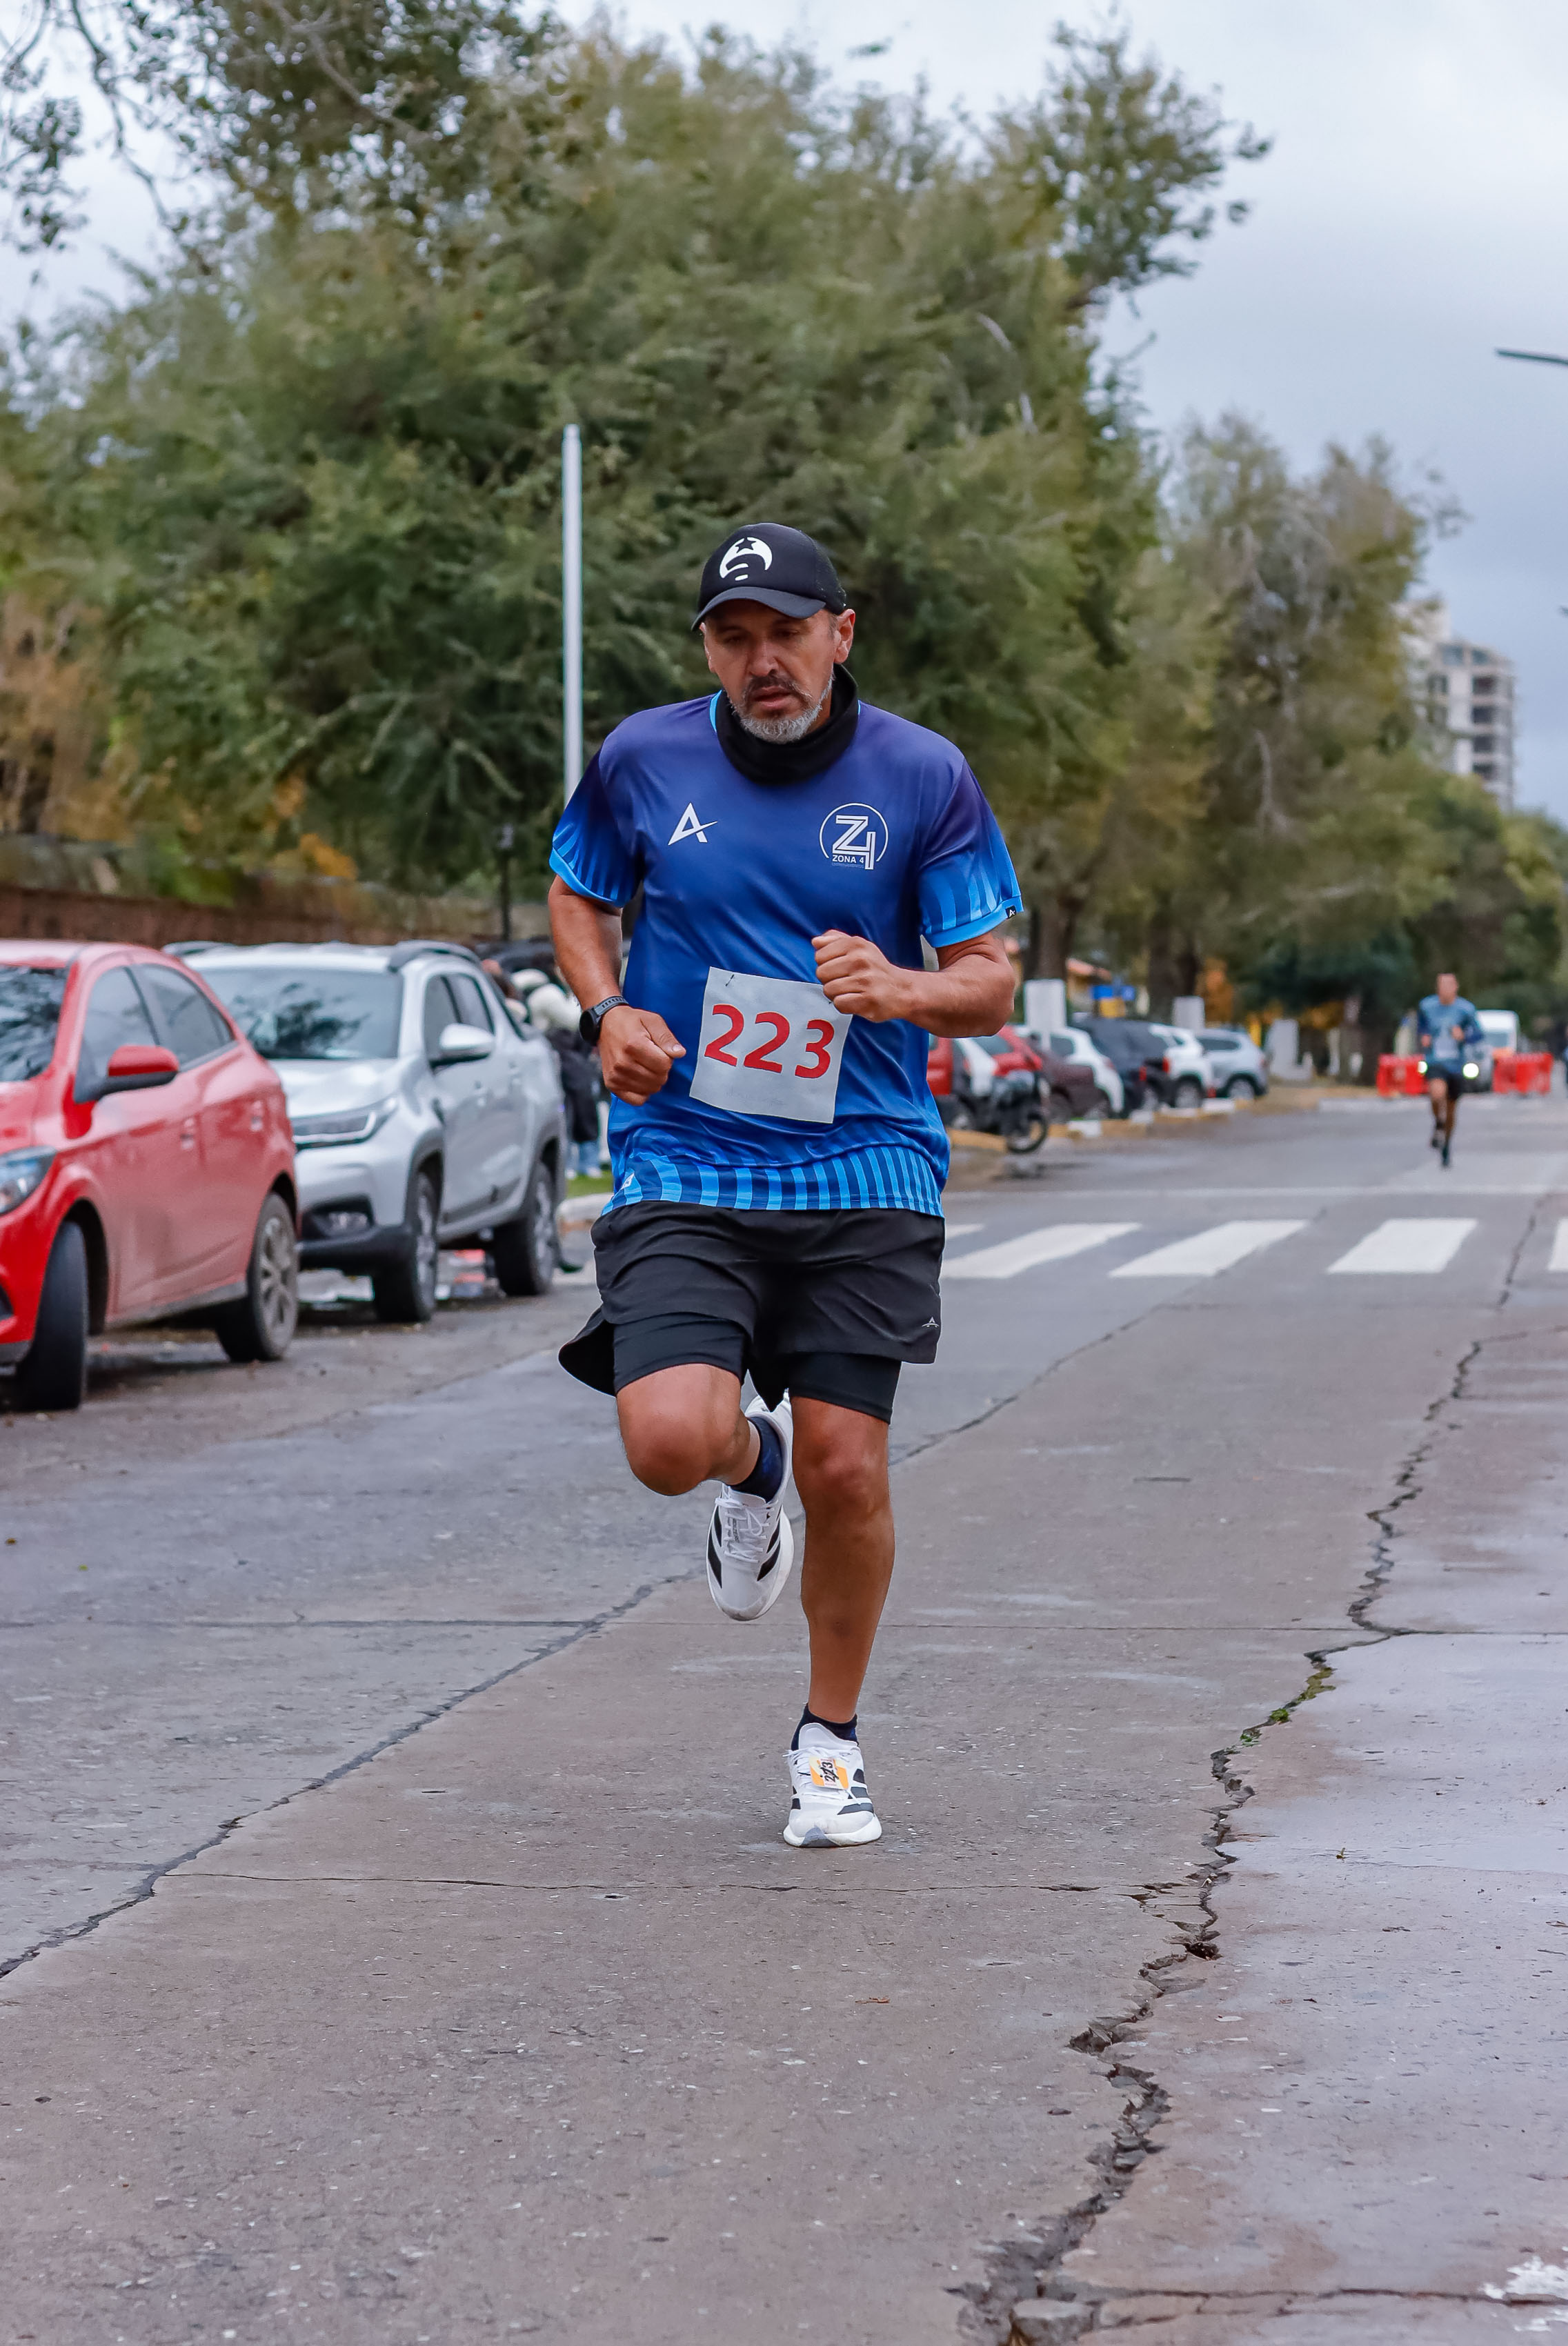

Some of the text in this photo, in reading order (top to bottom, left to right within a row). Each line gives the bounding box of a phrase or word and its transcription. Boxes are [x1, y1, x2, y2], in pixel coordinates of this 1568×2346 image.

[832, 854, 857, 863] ZONA
[704, 1004, 835, 1079] 223
[822, 1761, 837, 1783] 223
